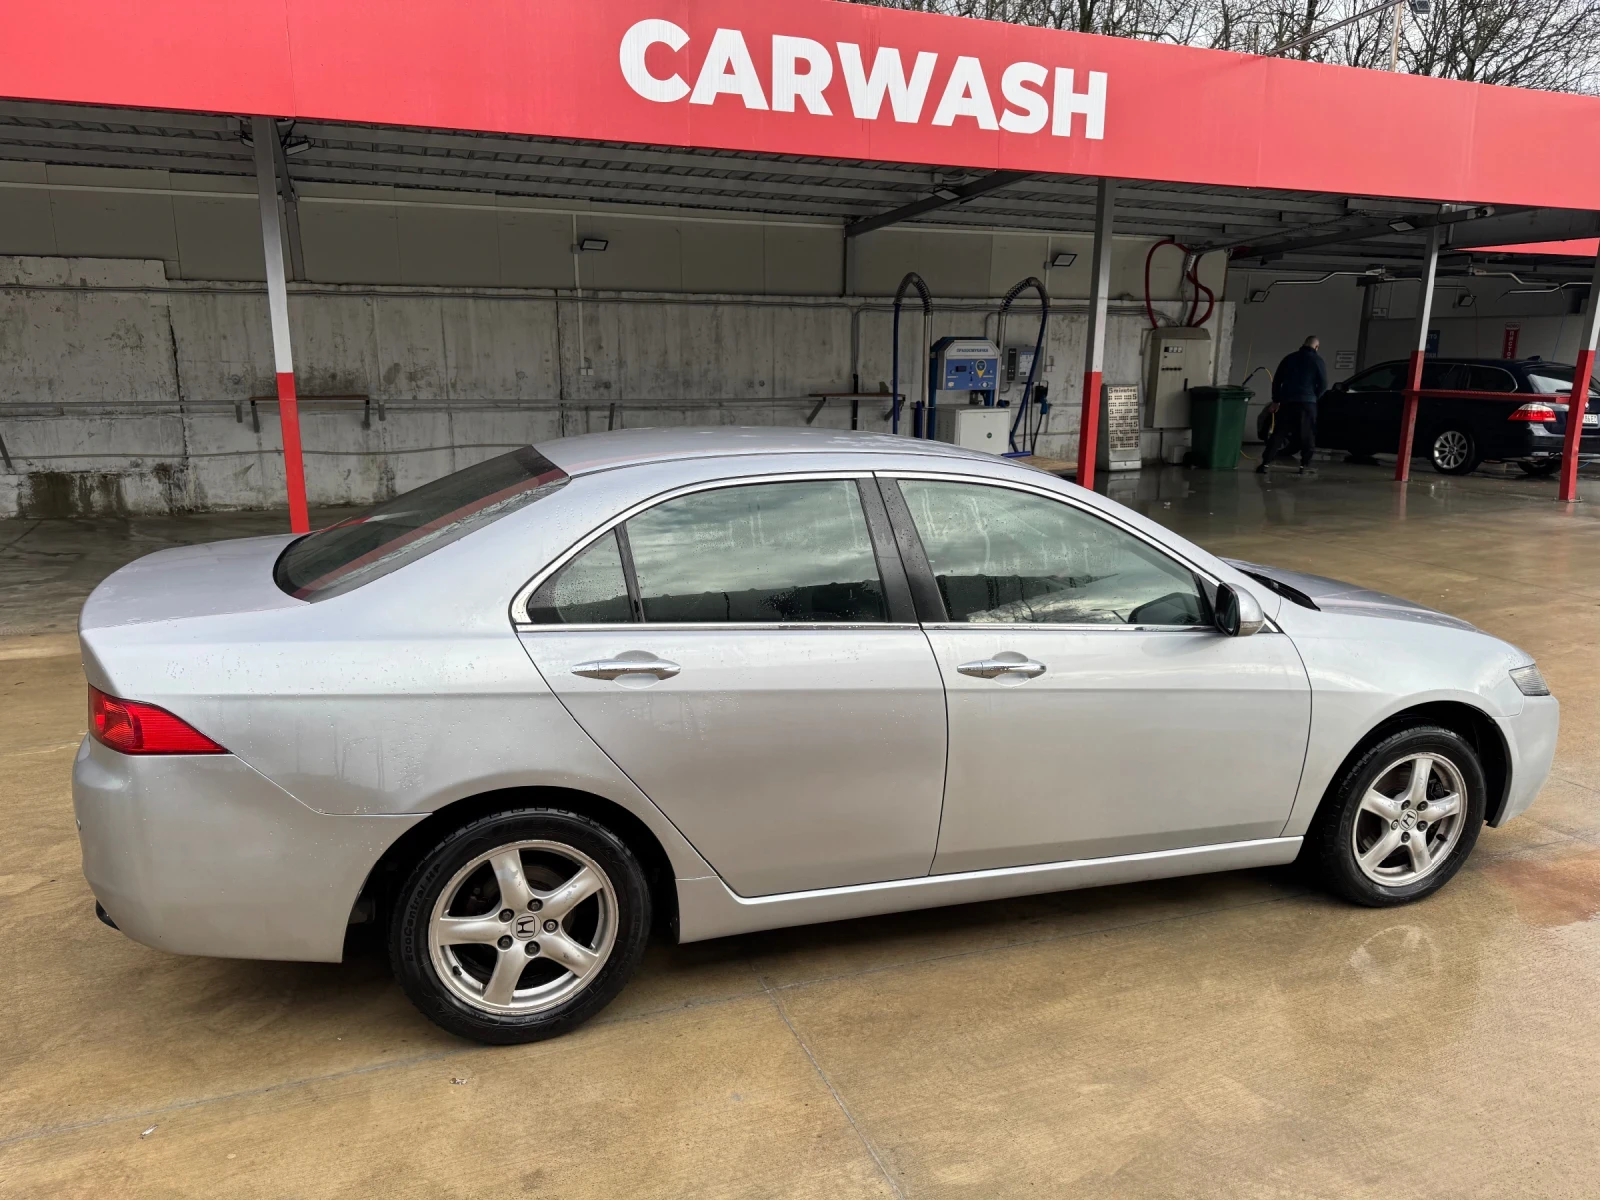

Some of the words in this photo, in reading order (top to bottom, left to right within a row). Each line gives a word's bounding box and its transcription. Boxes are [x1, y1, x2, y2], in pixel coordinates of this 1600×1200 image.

[619, 18, 1108, 140] CARWASH
[403, 883, 427, 962] EcoControl
[425, 862, 441, 883] HP
